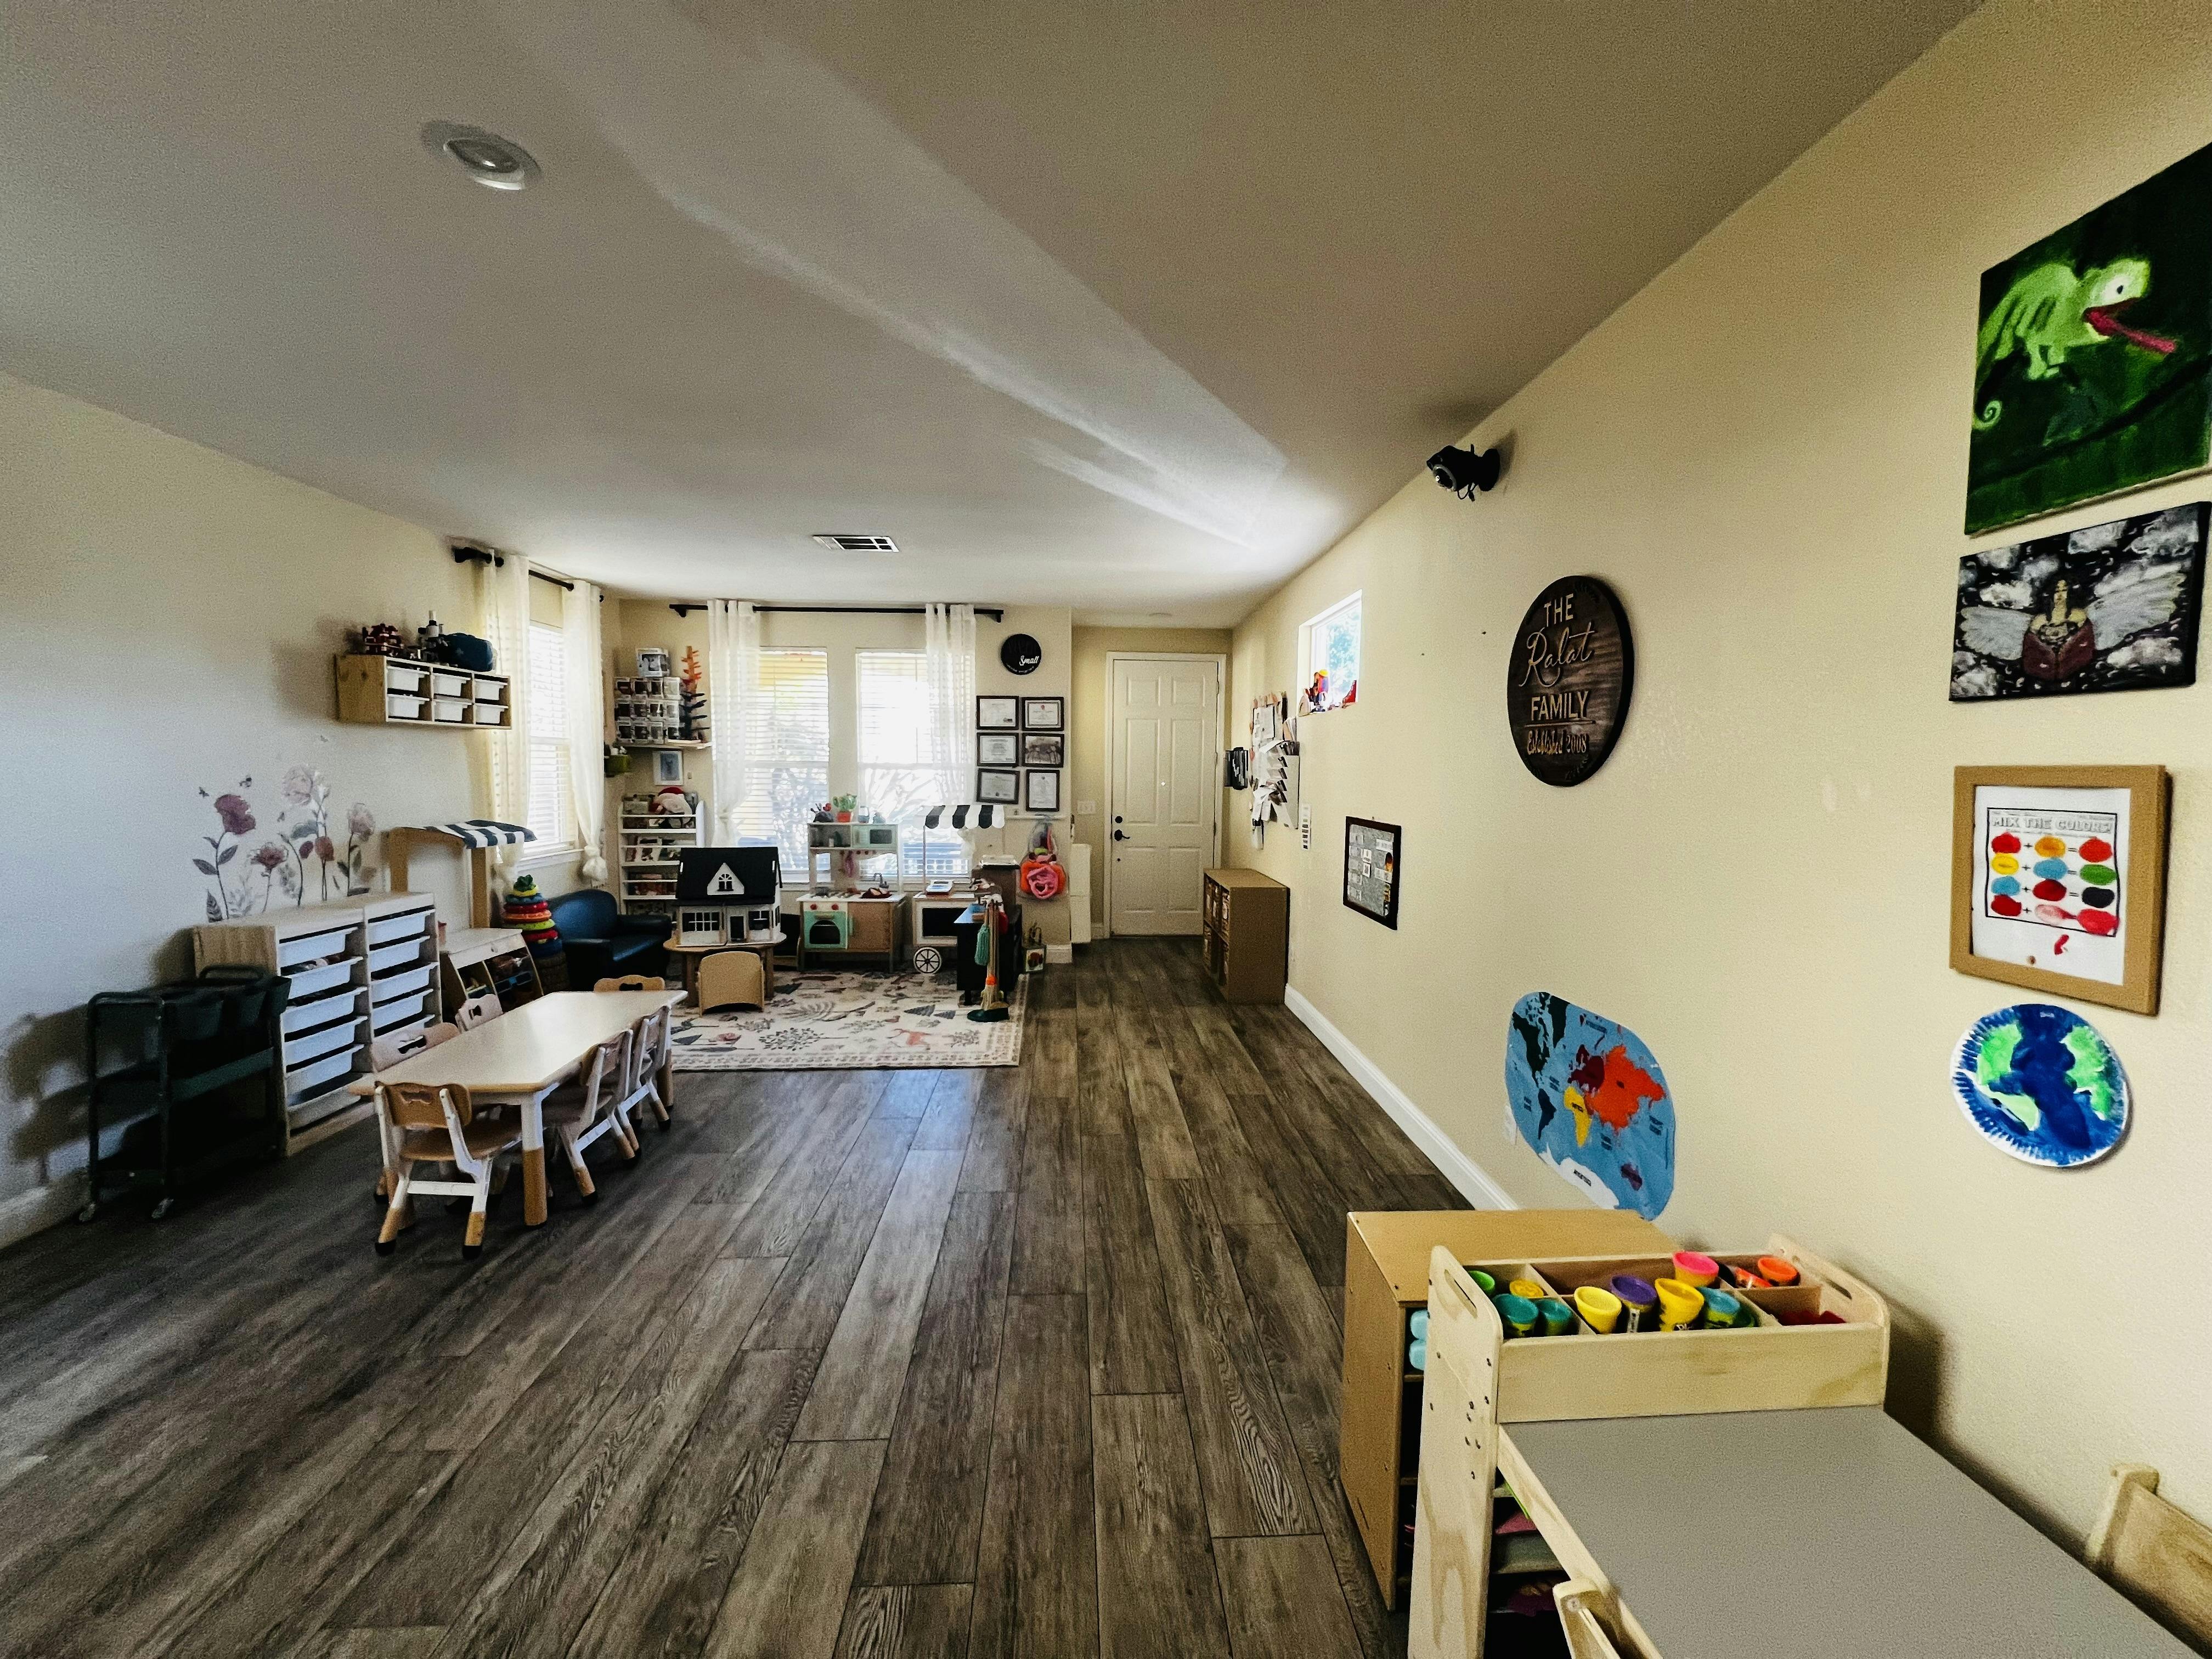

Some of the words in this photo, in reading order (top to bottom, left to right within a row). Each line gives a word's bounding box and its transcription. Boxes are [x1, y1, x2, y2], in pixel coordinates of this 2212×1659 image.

[1544, 593, 1574, 627] THE
[1019, 655, 1040, 666] Small
[1531, 691, 1589, 721] FAMILY
[1565, 733, 1587, 754] 2008
[1992, 816, 2020, 827] MIX
[2024, 817, 2052, 830] THE
